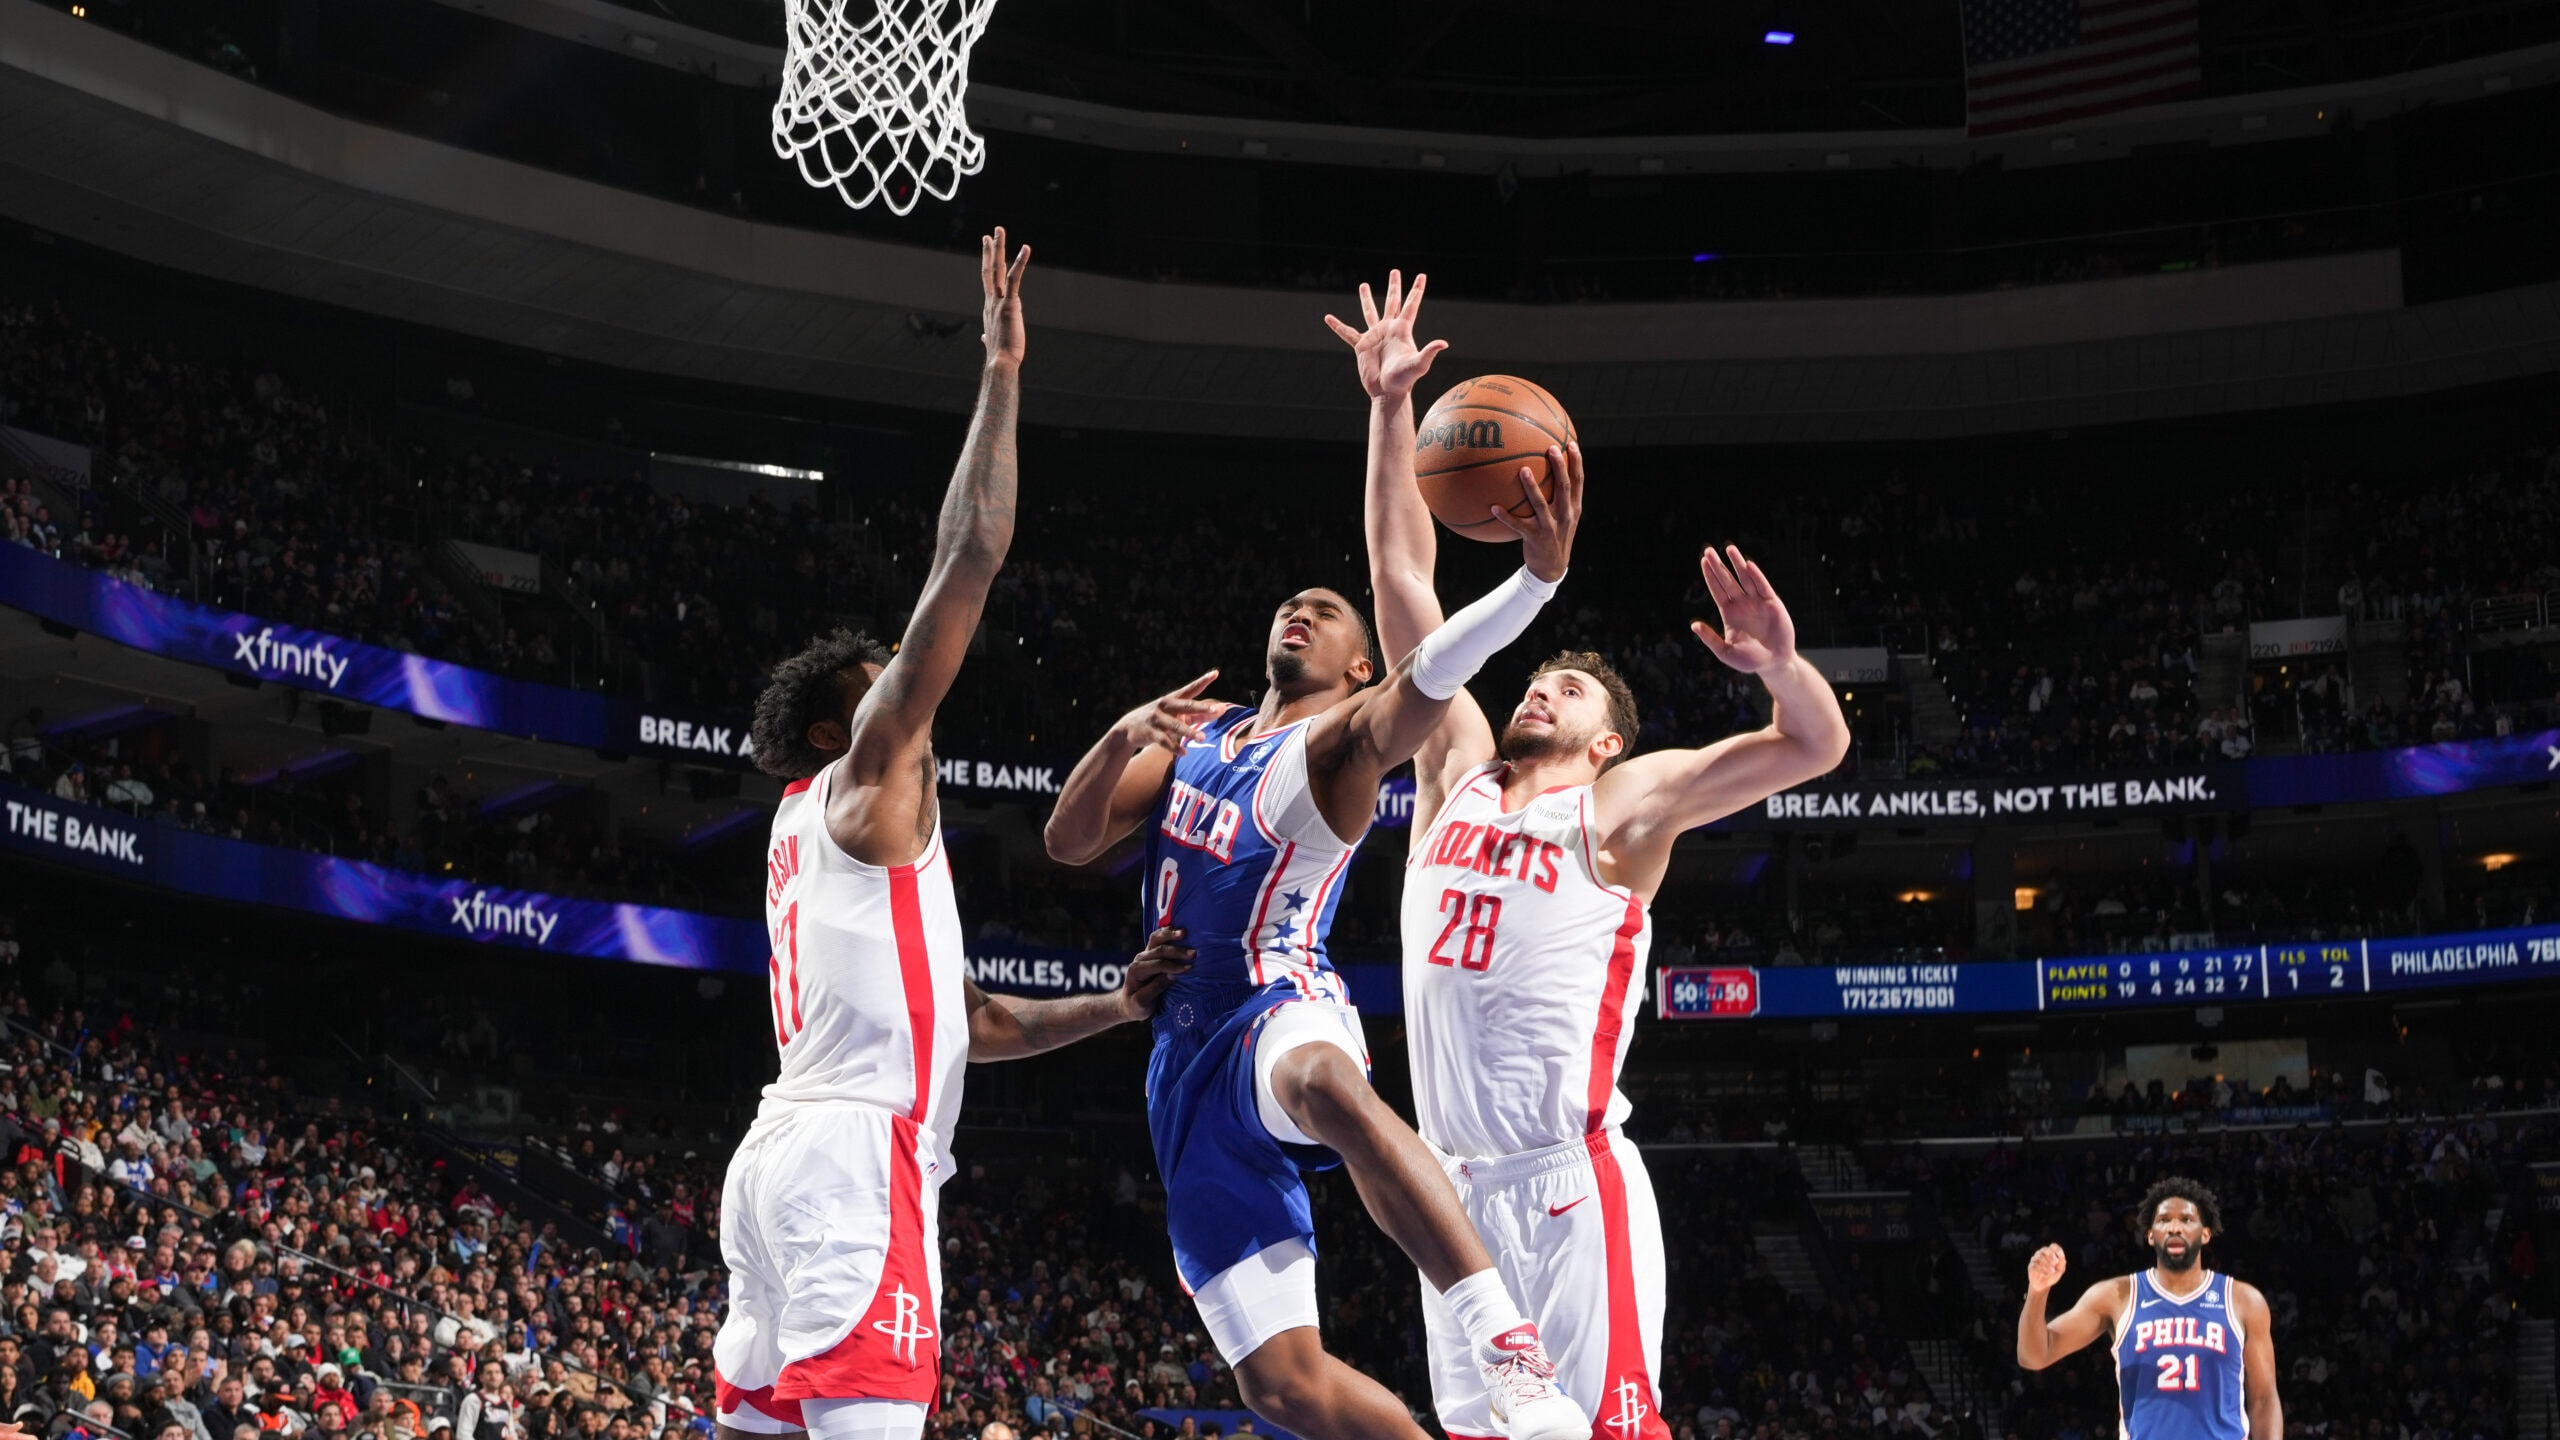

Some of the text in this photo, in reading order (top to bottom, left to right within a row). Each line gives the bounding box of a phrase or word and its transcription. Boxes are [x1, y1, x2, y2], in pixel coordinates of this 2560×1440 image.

[1416, 418, 1504, 452] Wilson
[233, 626, 349, 689] xfinity
[639, 714, 731, 756] BREAK
[976, 761, 1061, 793] BANK.
[1766, 775, 2216, 819] BREAK ANKLES, NOT THE BANK.
[5, 800, 144, 866] THE BANK.
[1421, 819, 1565, 896] ROCKETS
[450, 888, 559, 946] xfinity
[1426, 888, 1503, 973] 28
[2049, 954, 2253, 981] PLAYER 0 8 9 21 77
[2279, 948, 2350, 965] FLS TOL
[2391, 942, 2519, 976] PHILADELPHIA
[1835, 964, 1959, 987] WINNING TICKET
[2051, 975, 2249, 1001] POINTS 19 4 24 32 7
[2288, 965, 2345, 990] 1 2
[1673, 981, 1698, 1005] 50
[1724, 981, 1749, 1004] 50
[1842, 986, 1955, 1010] 17123679001
[2135, 1317, 2227, 1355] PHILA
[2156, 1354, 2200, 1391] 21
